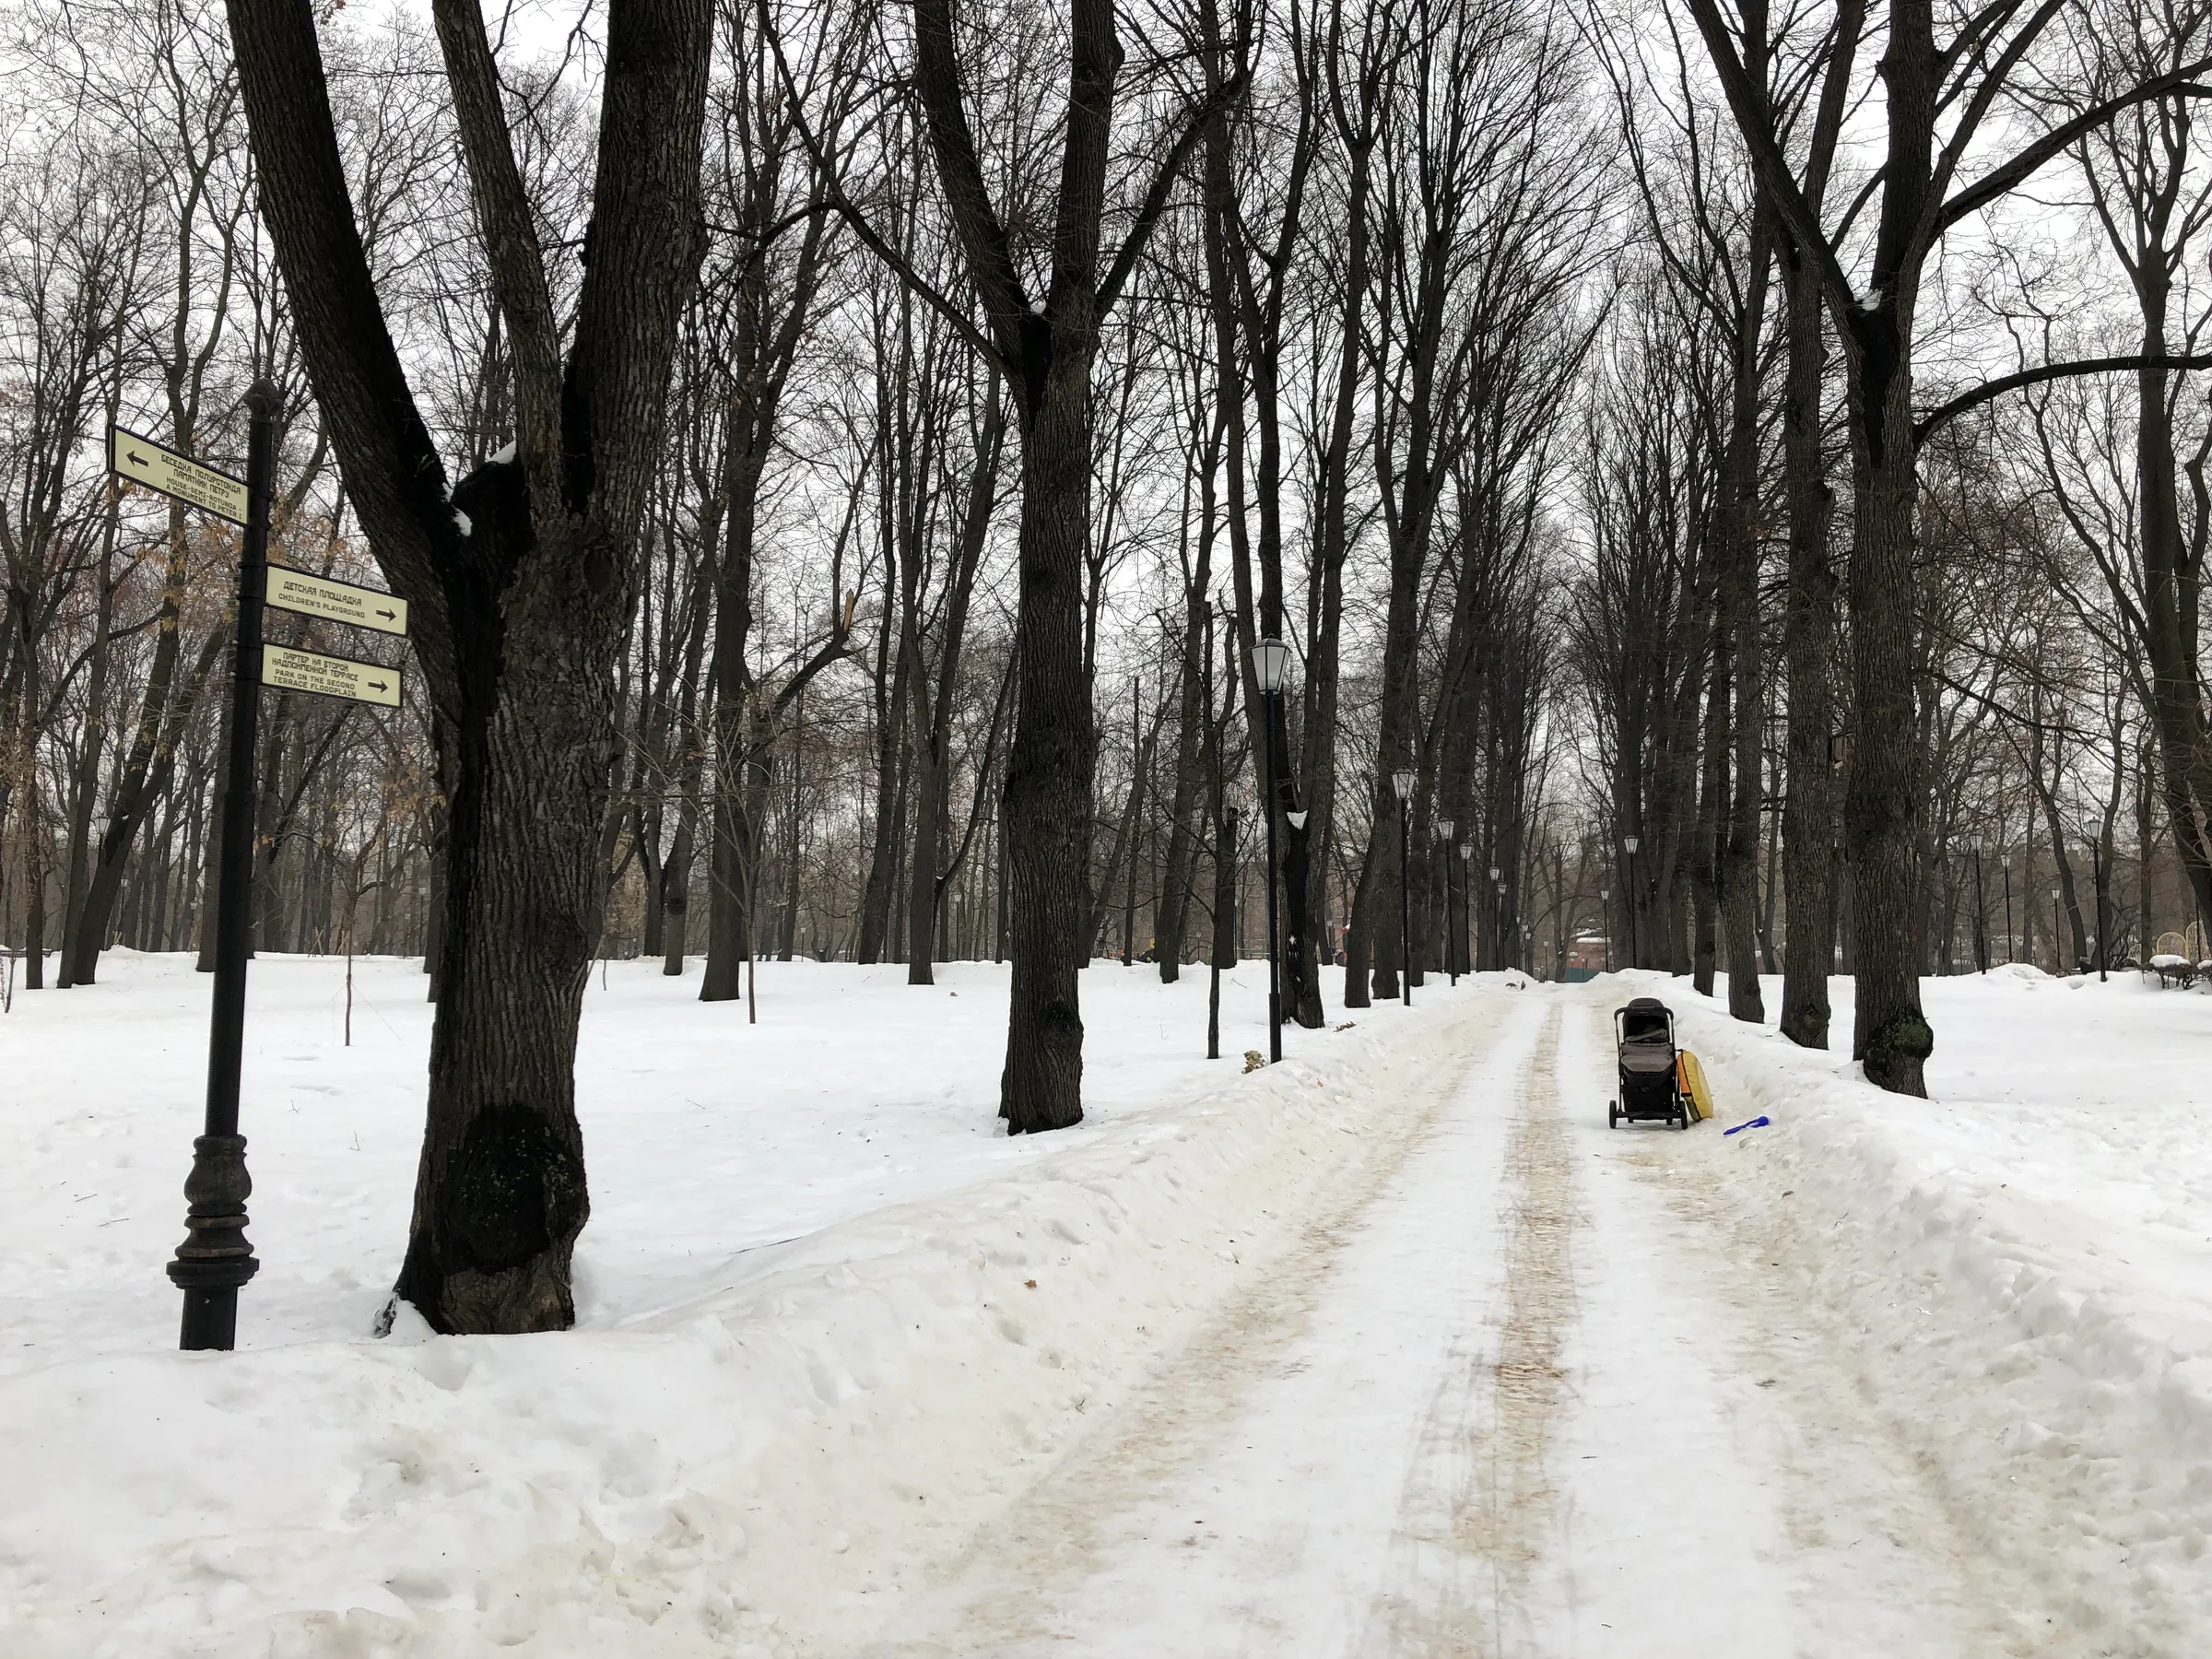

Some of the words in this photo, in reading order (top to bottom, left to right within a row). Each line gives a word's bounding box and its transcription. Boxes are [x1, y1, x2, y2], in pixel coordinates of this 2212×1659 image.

[161, 453, 192, 474] БЕСЕДКА
[195, 469, 241, 495] ПОЛУРОТОНДА
[173, 468, 207, 489] ПАМЯТНИК
[209, 484, 229, 498] ПЕТРУ
[172, 486, 206, 504] MONUMENT
[208, 500, 216, 509] TO
[218, 503, 237, 517] PETER
[278, 593, 321, 608] CHILDREN'S
[323, 603, 366, 618] PLAYGROUND
[283, 581, 317, 596] ДЕТСКАЯ
[319, 589, 362, 606] ПЛОЩАДКА
[282, 652, 310, 664] ПАРТЕР
[312, 657, 322, 666] НА
[324, 660, 348, 672] ВТОРОЙ
[273, 676, 308, 688] TERRACE
[310, 683, 357, 697] FLOODPLAIN
[275, 668, 295, 678] PARK
[310, 676, 324, 684] THE
[326, 678, 355, 690] SECOND
[330, 669, 359, 682] ТЕРРАСЕ
